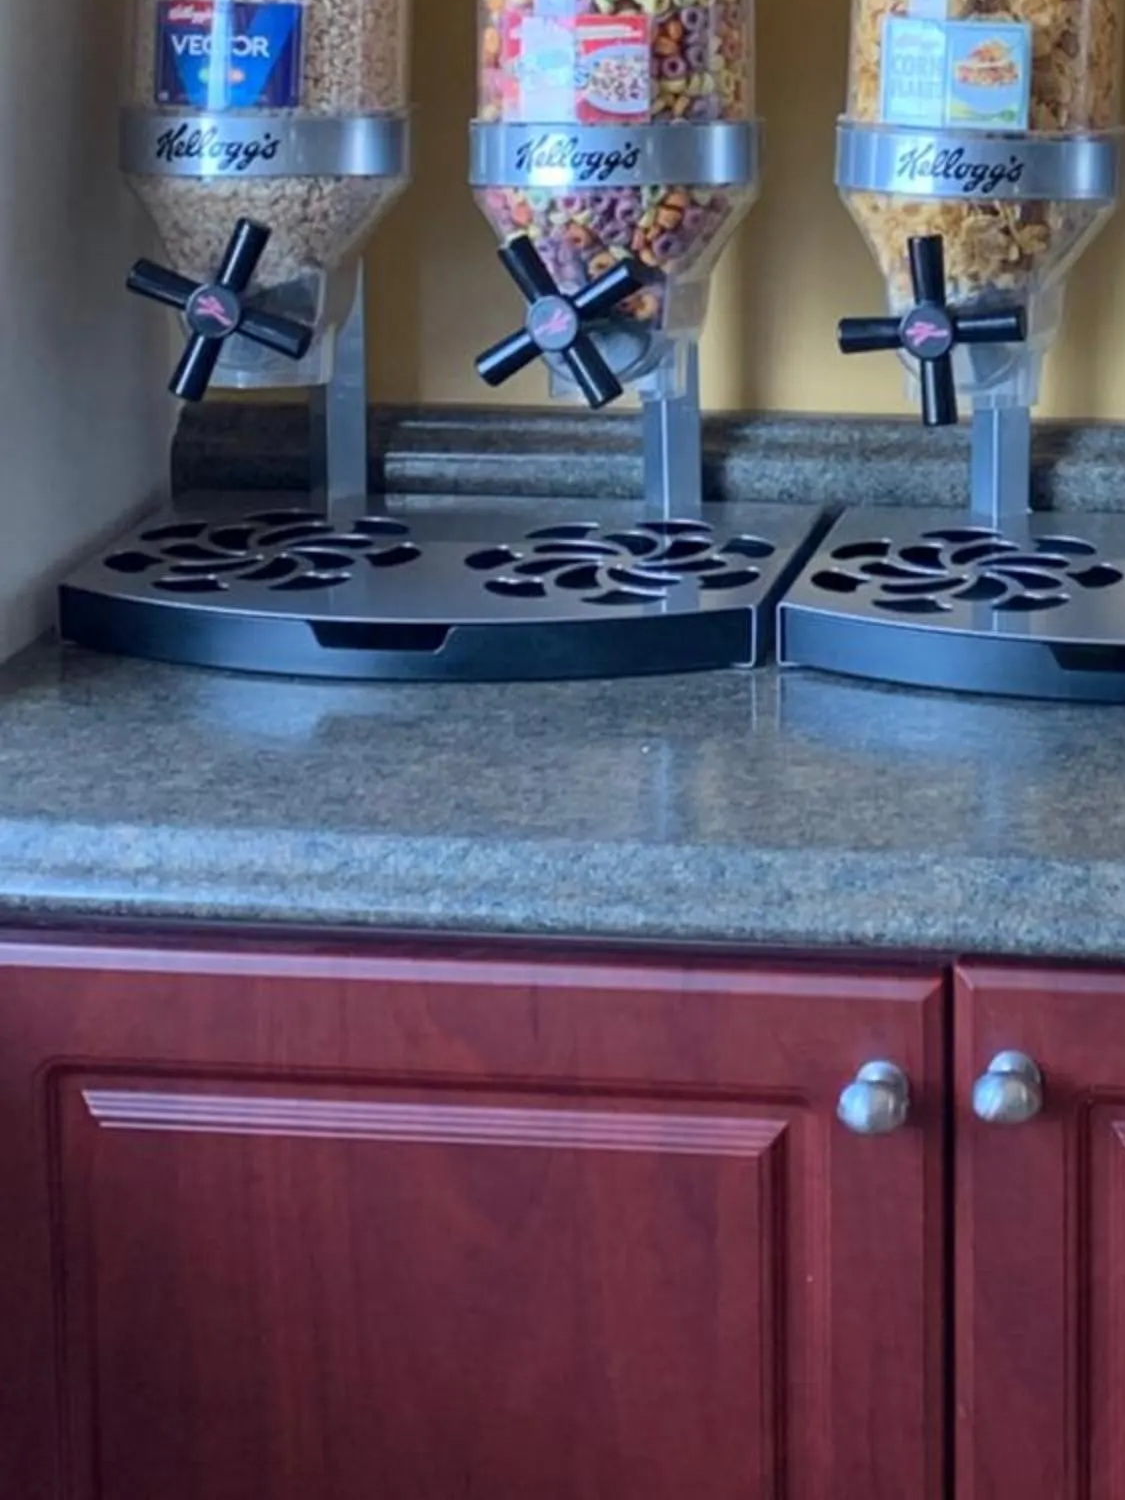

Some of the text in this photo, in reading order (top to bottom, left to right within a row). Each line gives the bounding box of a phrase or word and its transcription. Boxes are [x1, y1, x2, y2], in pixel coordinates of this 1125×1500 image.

[156, 122, 282, 171] Kellogg's
[515, 138, 642, 181] Kellogg's
[896, 143, 1025, 194] Kellogg's
